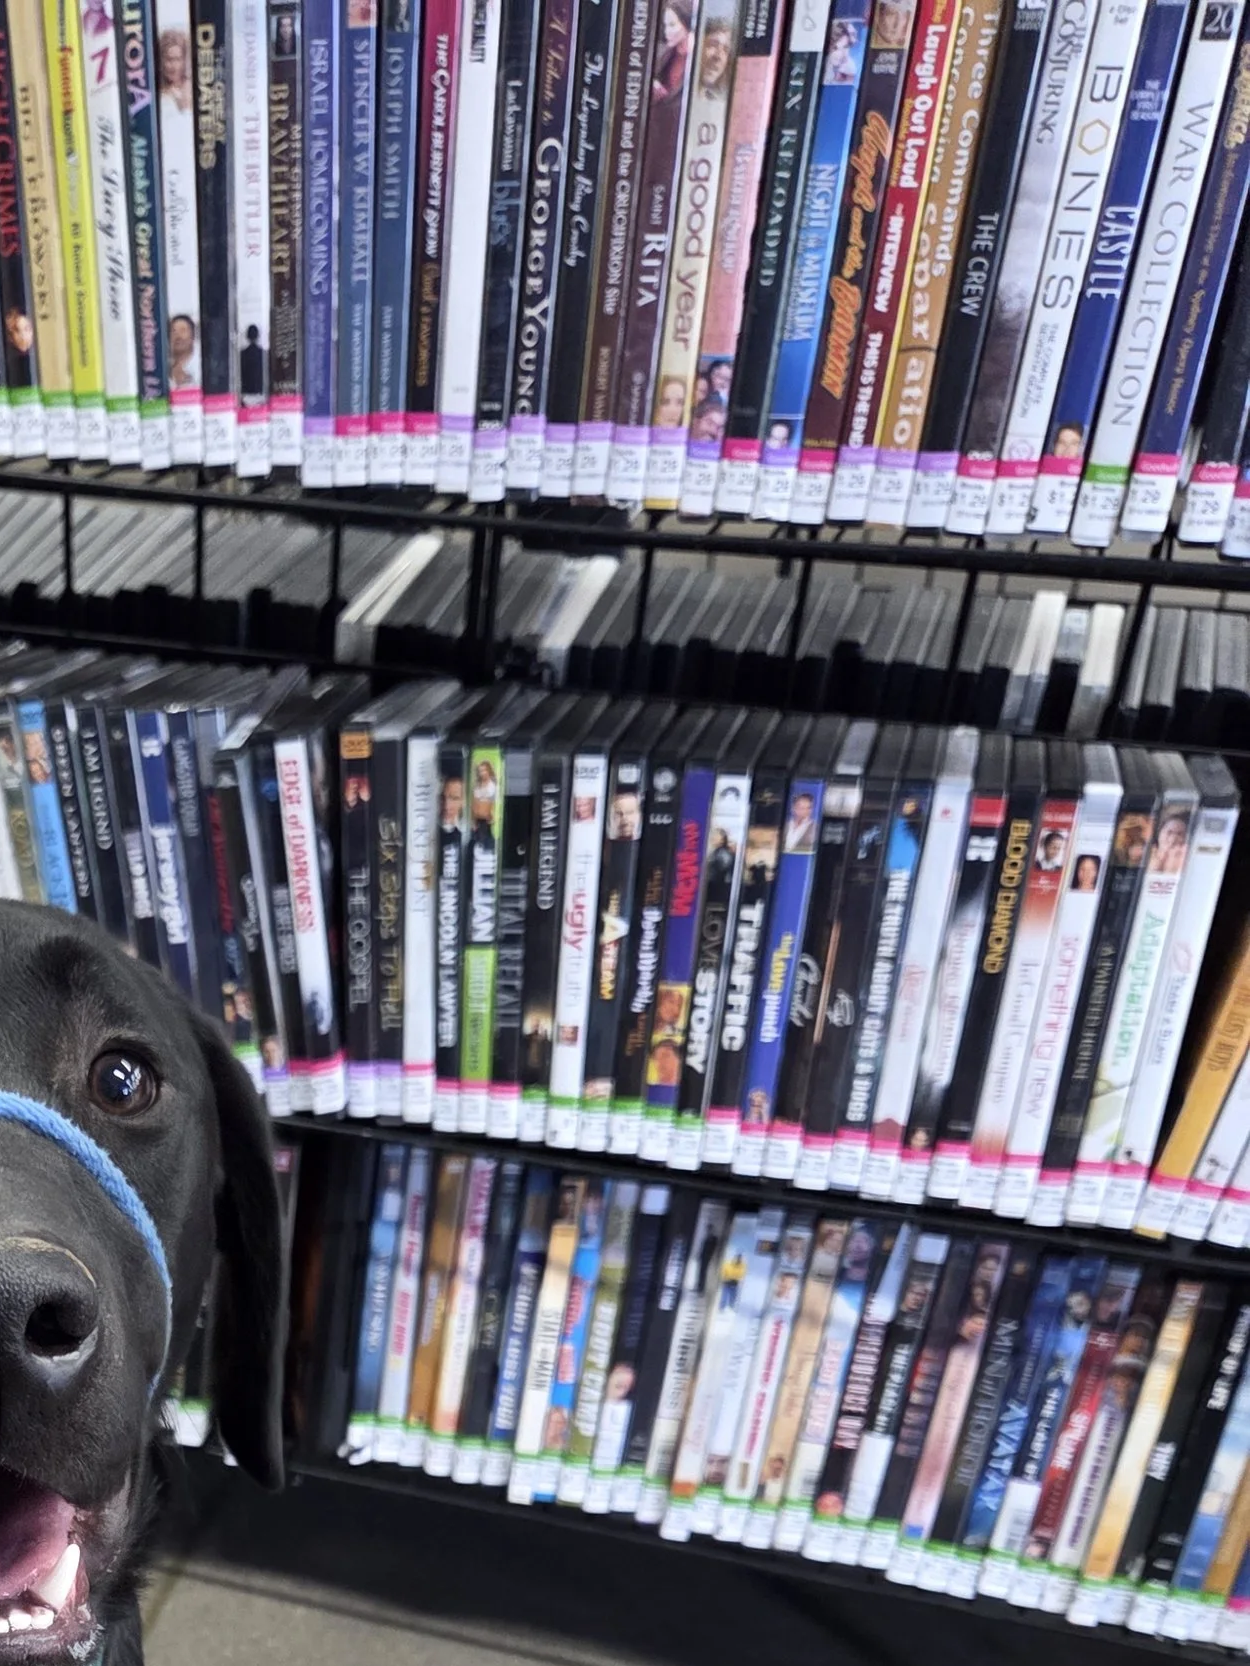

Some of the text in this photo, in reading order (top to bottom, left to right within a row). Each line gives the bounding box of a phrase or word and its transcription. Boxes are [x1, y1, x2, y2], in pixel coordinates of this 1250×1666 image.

[122, 0, 151, 118] urorA
[435, 33, 450, 68] THE
[629, 51, 644, 68] of
[630, 0, 648, 49] RDEN
[1034, 2, 1088, 145] CONJURING
[197, 22, 217, 170] DEBATERS
[213, 80, 228, 143] GREAT
[308, 38, 329, 122] ISRAEL
[350, 38, 373, 147] SPENCER
[428, 68, 451, 129] CAROL
[622, 70, 642, 118] EDEN
[901, 24, 947, 190] Laugh Out Loud
[130, 134, 152, 219] Alaska's
[269, 82, 292, 277] BRAVEHEART
[381, 47, 407, 221] JOSEPH SMITH
[489, 78, 523, 247] Lackawanna blues
[563, 51, 605, 268] The Legendary Bing Crosby
[616, 152, 633, 177] the
[619, 120, 637, 148] and
[931, 9, 1002, 279] Three Commands
[1167, 100, 1216, 188] WAR
[94, 117, 131, 322] The Lucy Show
[308, 127, 332, 296] HOMECOMING
[350, 185, 371, 283] KIMBALL
[424, 207, 443, 259] SHOW
[524, 136, 563, 296] GEORGE
[603, 180, 631, 286] CRUCIFIXION
[670, 122, 720, 352] a good year
[758, 126, 801, 288] RELOADED
[811, 162, 841, 229] NIGHT
[847, 205, 867, 246] and
[1032, 64, 1127, 405] BONES THE COMPLETE
[134, 224, 153, 279] Great
[635, 231, 667, 308] RITA
[792, 252, 833, 341] MUSEUM
[872, 213, 905, 313] INTERVIEW
[957, 211, 1001, 318] THE CREW
[1084, 203, 1139, 301] CASTLE
[137, 284, 158, 372] Northern
[601, 287, 620, 316] Site
[819, 274, 863, 400] BADMAN
[1110, 201, 1185, 427] COLLECTION
[1182, 289, 1207, 335] Sydney
[848, 331, 886, 450] THIS IS THE END
[1018, 321, 1047, 419] SEVENTH SEASON
[1174, 336, 1196, 376] Opera
[85, 742, 103, 773] AM
[279, 759, 303, 805] EDGE
[540, 797, 558, 829] AM
[288, 834, 316, 934] DARKNESS
[472, 845, 499, 942] JILLIAN
[536, 832, 556, 910] LEGEND
[886, 870, 911, 901] THE
[982, 819, 1032, 974] BLOOD DIAMOND
[348, 866, 372, 1012] THE GOSPEL
[375, 816, 403, 1032] Six Steps To Hell
[437, 843, 460, 1048] THE LINCOLN LAWYER
[562, 892, 593, 949] ugly
[876, 903, 906, 957] TRUTH
[685, 969, 718, 1075] STORY
[721, 901, 766, 1052] TRAFFIC
[866, 960, 894, 1013] ABOUT
[1111, 910, 1169, 1069] Adaptation.
[857, 1015, 886, 1058] CATS
[1025, 933, 1083, 1120] something new
[846, 1078, 872, 1123] DOGS
[973, 1401, 1029, 1512] AVATAR
